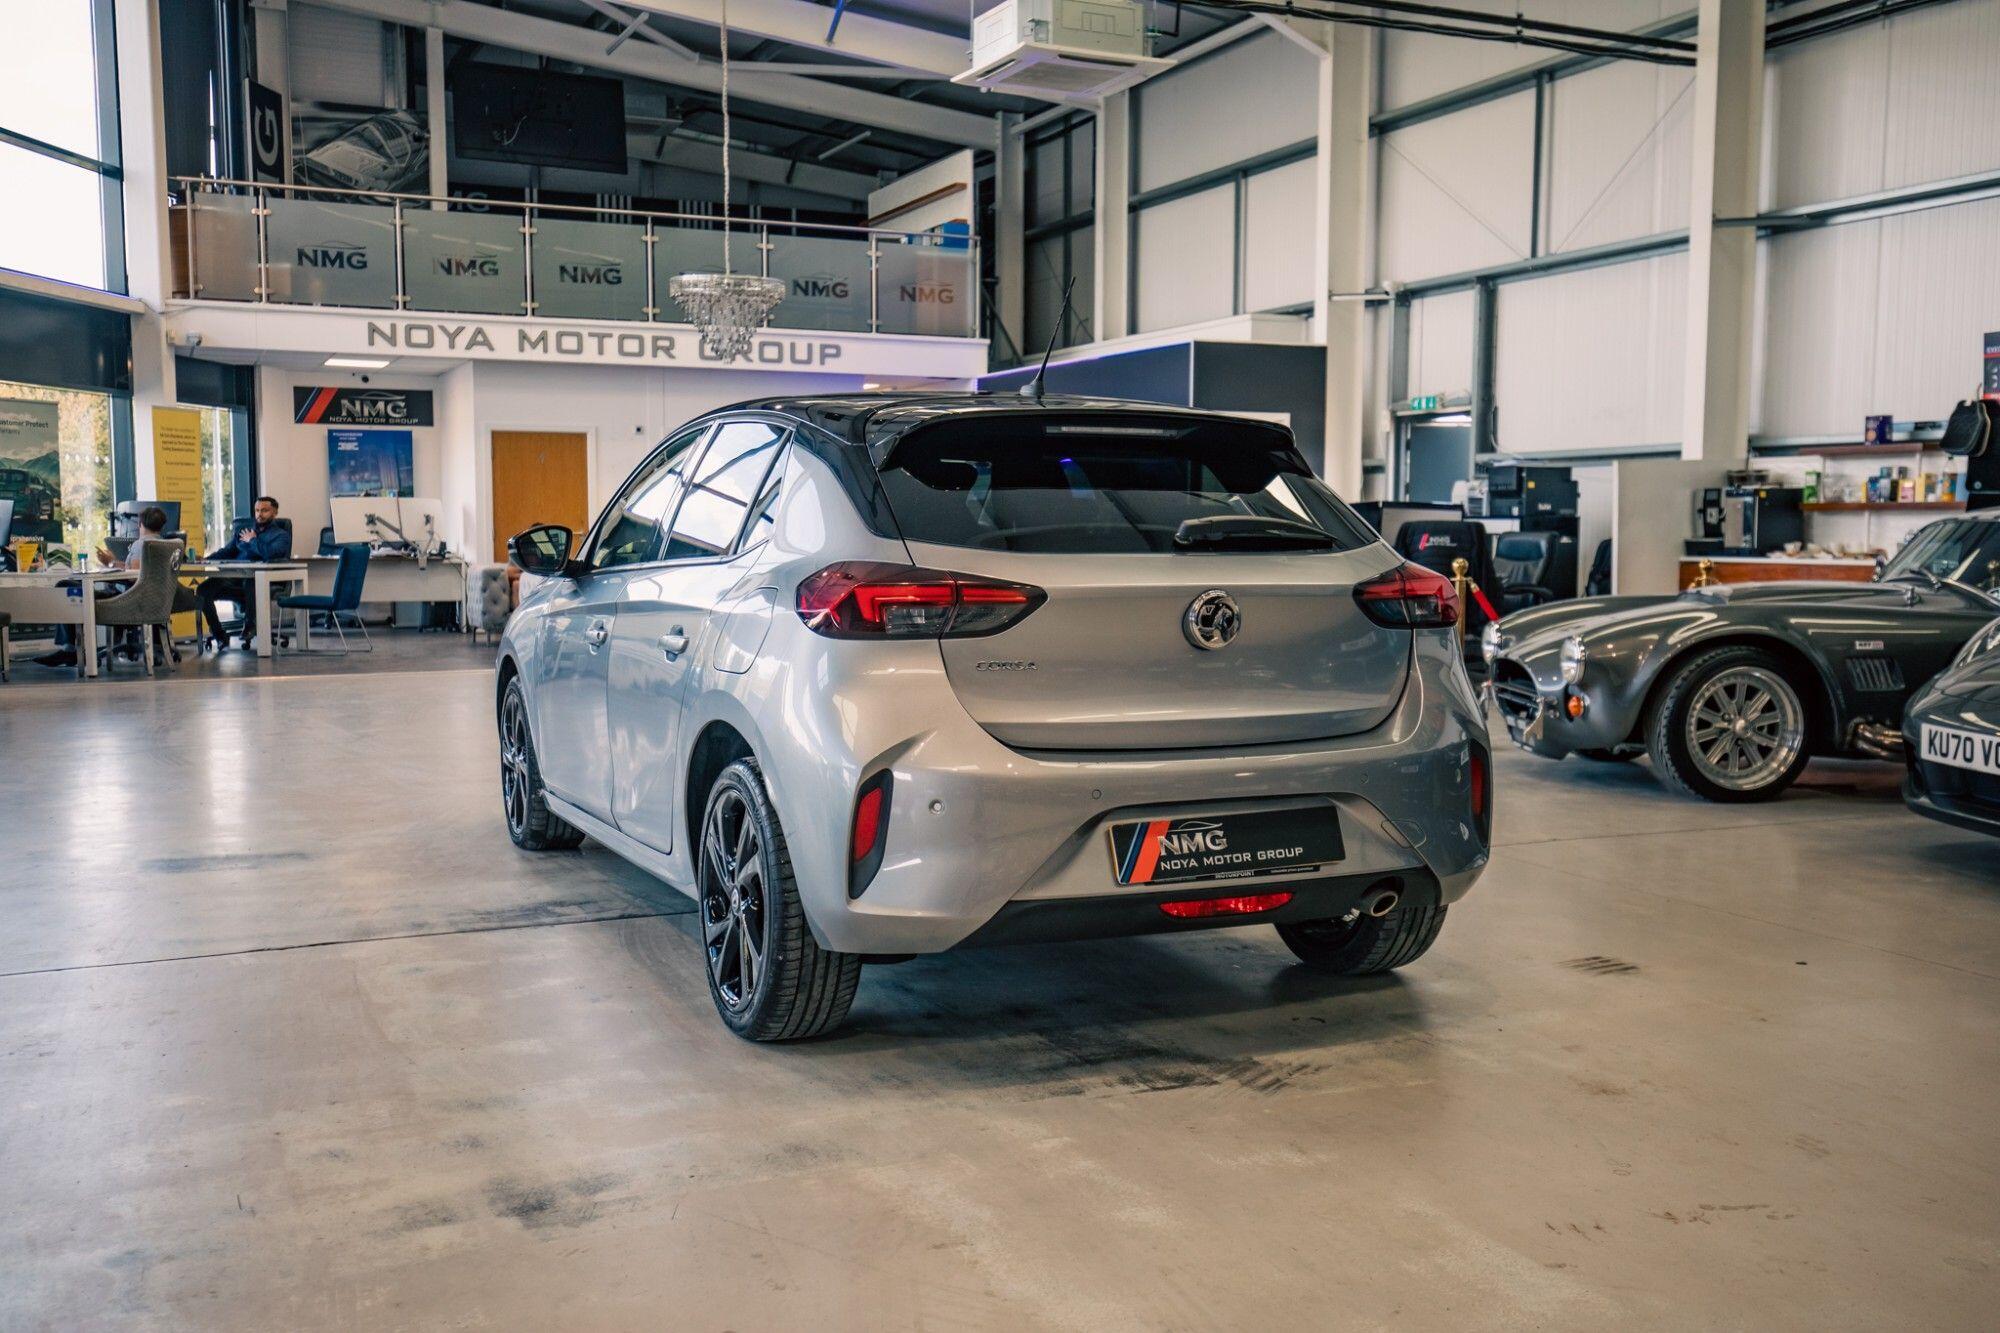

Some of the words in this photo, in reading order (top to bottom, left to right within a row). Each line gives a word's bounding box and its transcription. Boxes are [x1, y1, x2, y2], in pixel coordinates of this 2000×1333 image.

[297, 248, 368, 270] NMG
[432, 257, 499, 276] NMG
[559, 264, 623, 285] NMG
[792, 279, 849, 298] NMG
[900, 286, 954, 304] NMG
[367, 321, 495, 352] NOYA
[517, 328, 676, 360] MOTOR
[340, 399, 407, 418] NMG
[976, 660, 1038, 671] CORSA
[1928, 728, 1975, 763] KU70
[1157, 830, 1228, 857] NMG
[1160, 859, 1198, 871] NOYA
[1203, 853, 1252, 866] MOTOR
[1257, 847, 1304, 861] GROUP
